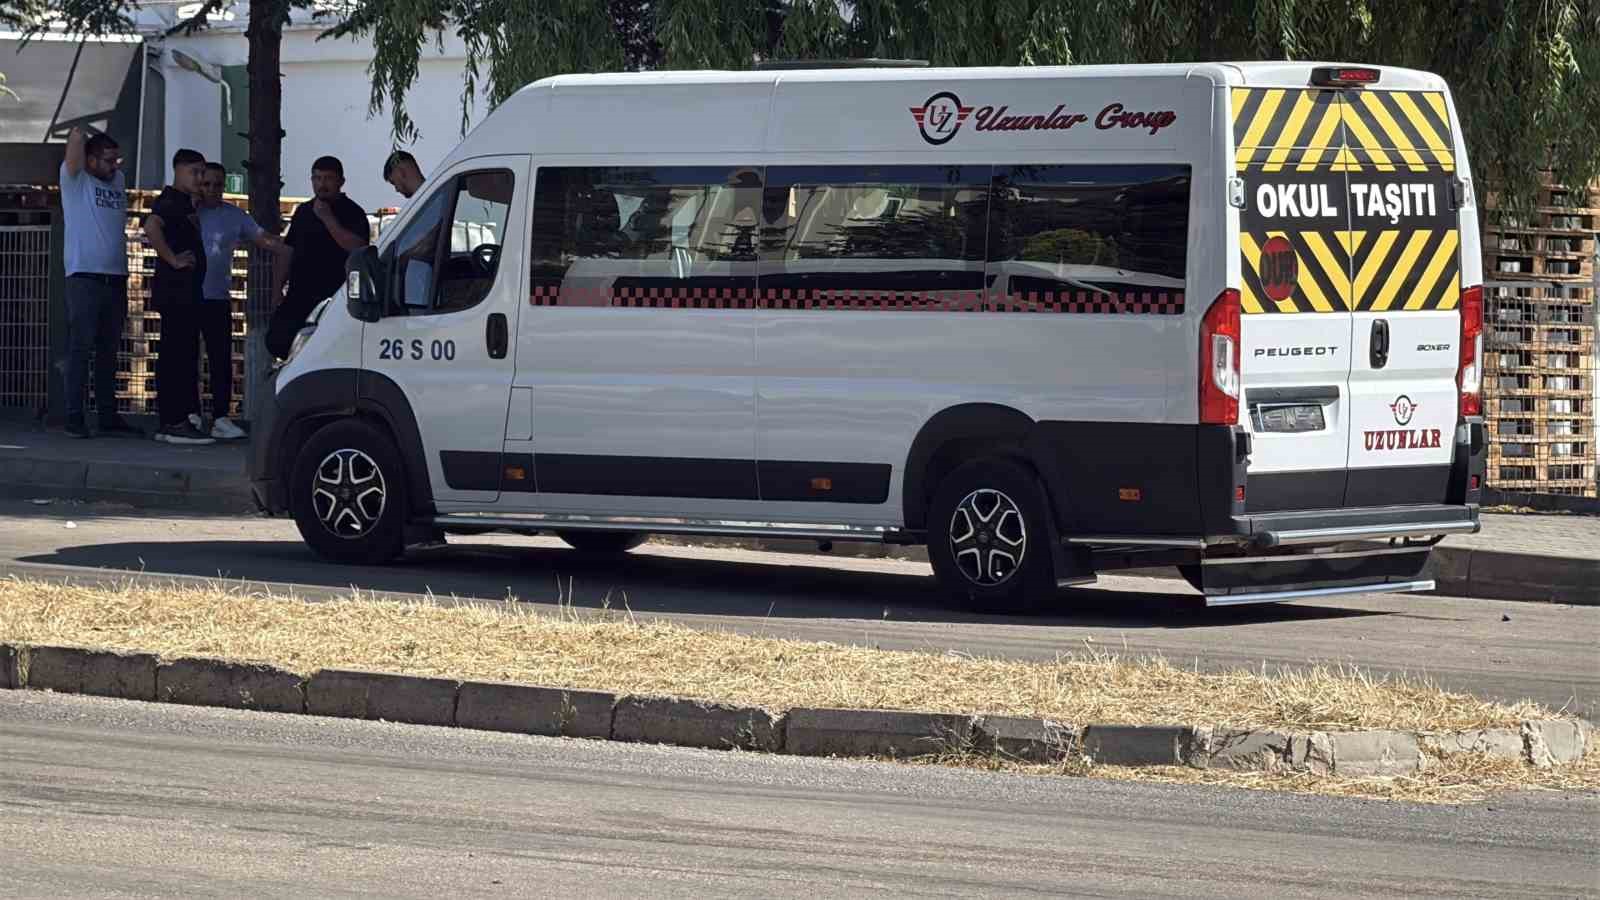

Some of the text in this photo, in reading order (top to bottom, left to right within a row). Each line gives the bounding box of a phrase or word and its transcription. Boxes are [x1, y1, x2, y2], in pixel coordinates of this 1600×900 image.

[974, 103, 1177, 135] Uzunlar Group
[1256, 183, 1437, 224] OKUL TAŞITI
[379, 338, 456, 360] 26 S 00
[1254, 346, 1338, 357] PEUGEOT
[1416, 343, 1451, 352] BOXER
[1363, 429, 1441, 451] UZUNLAR
